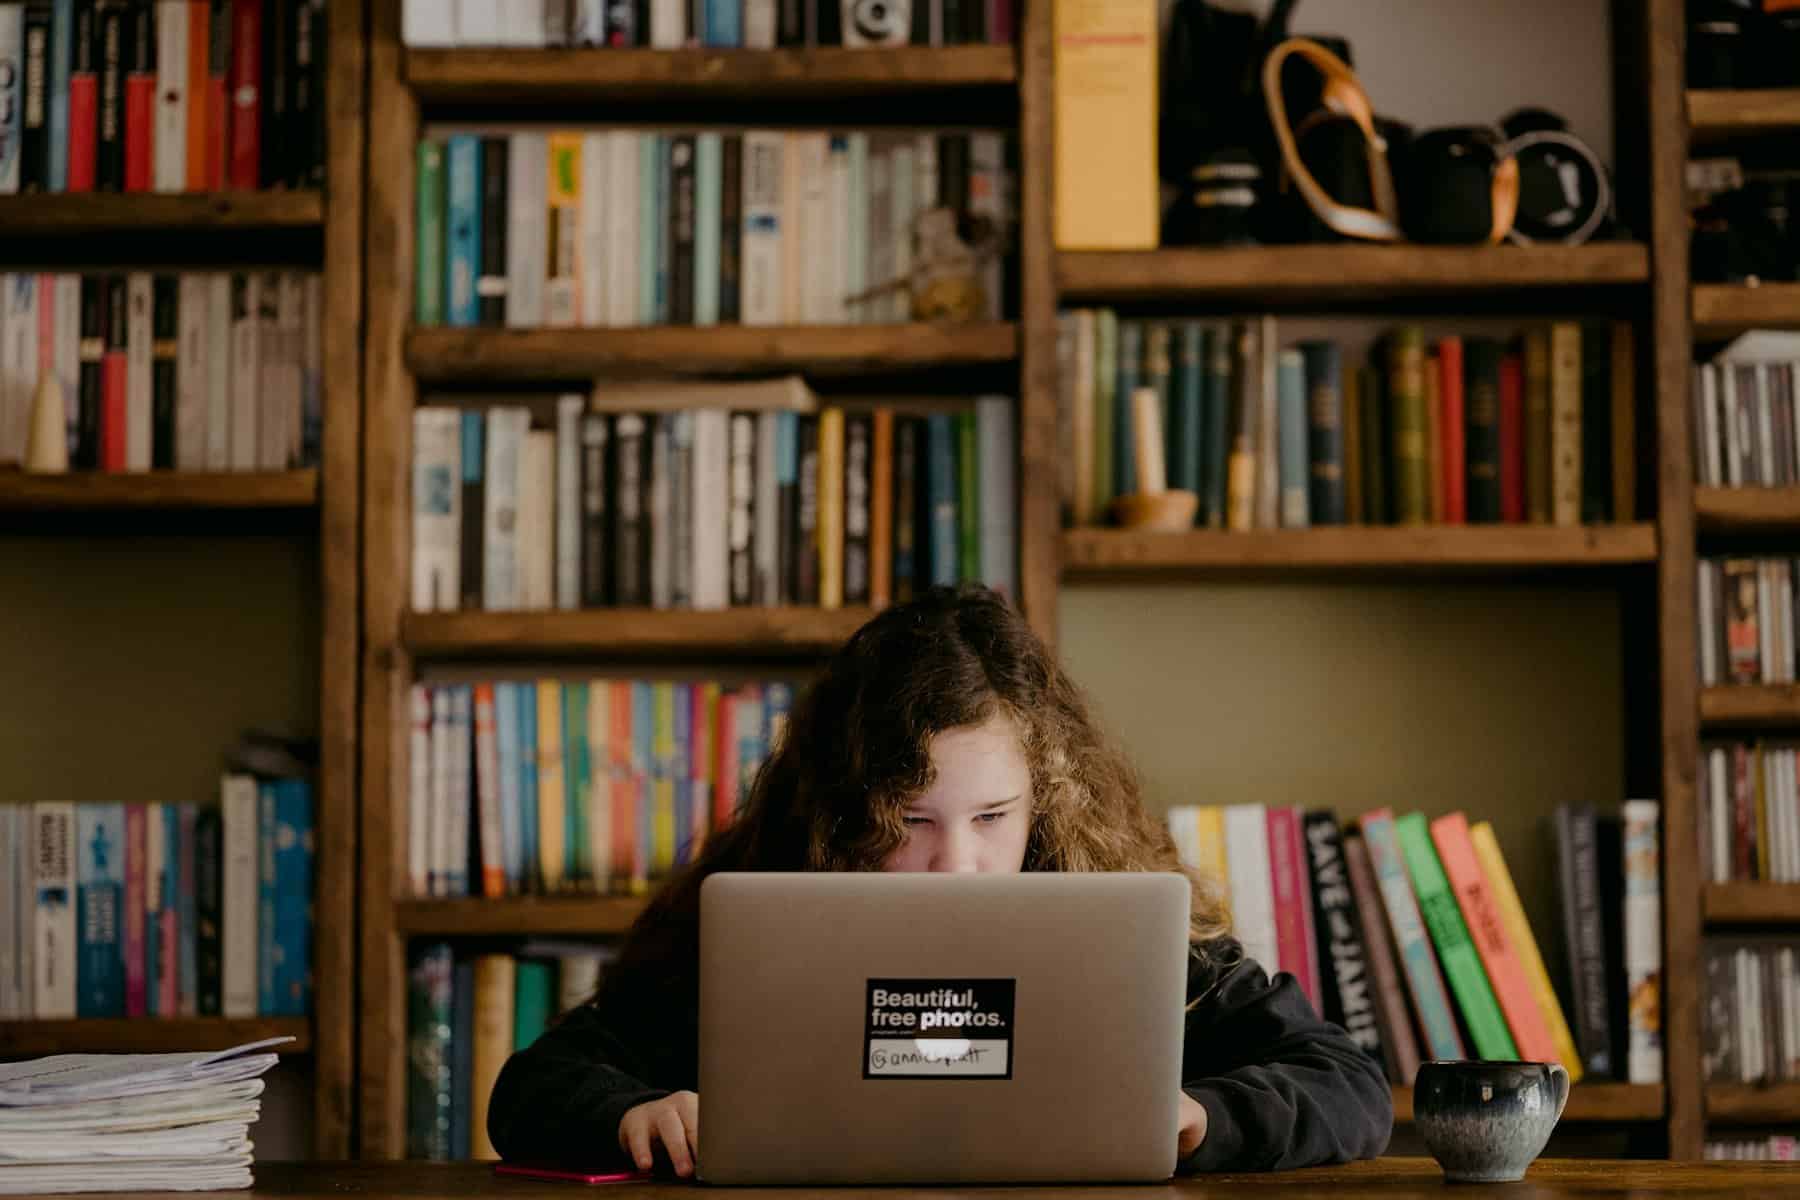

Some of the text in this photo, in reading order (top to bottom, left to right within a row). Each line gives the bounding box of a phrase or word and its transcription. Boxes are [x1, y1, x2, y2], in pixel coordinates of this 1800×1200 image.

[872, 988, 979, 1010] Beautiful,
[871, 1008, 1006, 1031] free photos.
[871, 1048, 991, 1070] @anniatt
